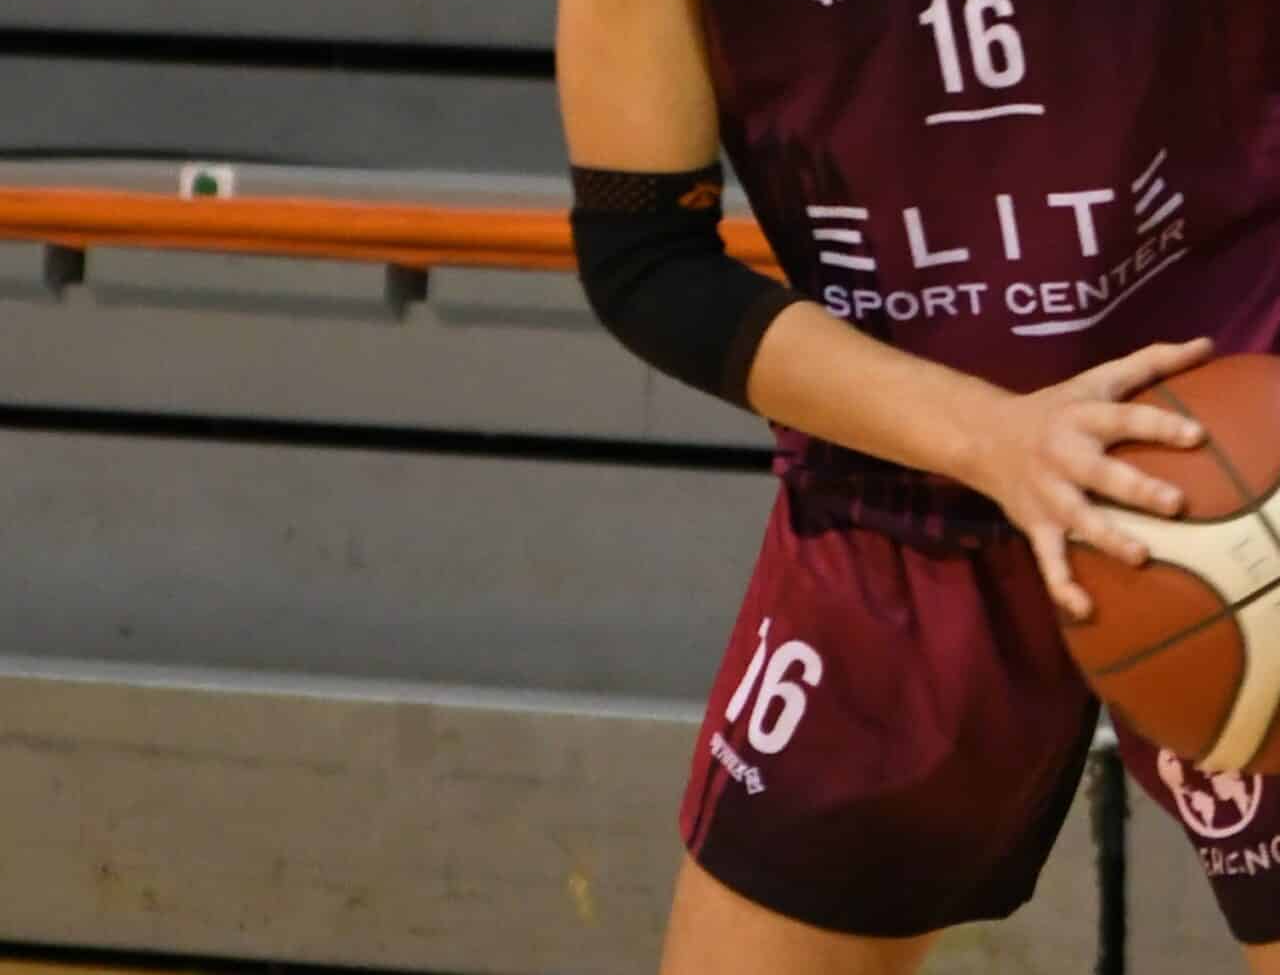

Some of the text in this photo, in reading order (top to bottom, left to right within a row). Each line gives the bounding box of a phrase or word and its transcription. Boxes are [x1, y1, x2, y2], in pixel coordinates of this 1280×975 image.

[805, 147, 1184, 272] ELITE
[824, 218, 1185, 321] SPORT CENTER
[725, 616, 824, 755] 16
